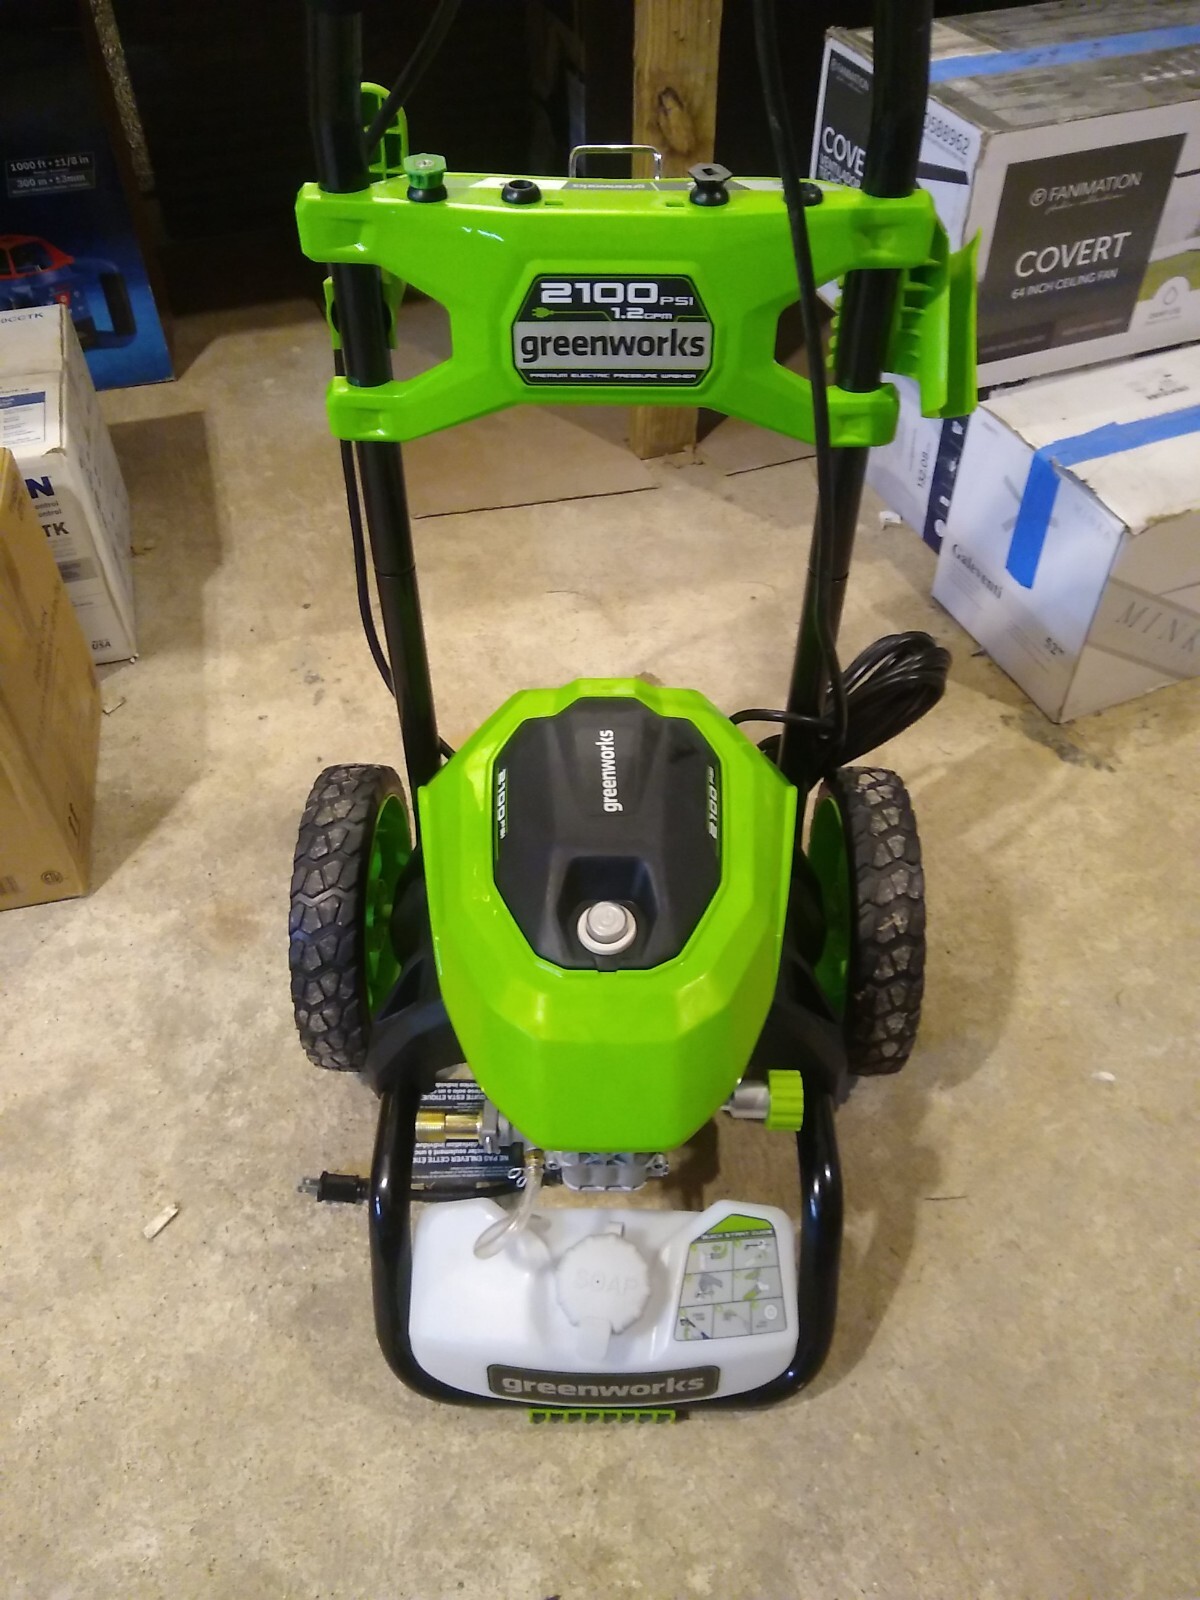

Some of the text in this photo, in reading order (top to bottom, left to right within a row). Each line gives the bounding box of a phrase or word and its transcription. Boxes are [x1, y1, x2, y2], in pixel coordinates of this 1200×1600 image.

[11, 160, 36, 172] 1000
[37, 160, 47, 169] ft
[79, 156, 90, 164] in
[822, 126, 866, 177] COVE
[16, 178, 36, 188] 300
[38, 178, 48, 186] m
[1047, 172, 1143, 202] FANIMATION
[1014, 231, 1132, 278] COVERT
[1010, 267, 1119, 300] 64 INCH CEILING FAN
[521, 328, 705, 363] greenworks
[34, 501, 59, 510] ontrol
[38, 509, 62, 518] ontrol
[595, 729, 624, 813] greenworks
[426, 1156, 450, 1164] CETTE
[451, 1155, 482, 1164] ENLEVER
[572, 1267, 639, 1296] SOAP
[502, 1376, 705, 1398] greenworks
